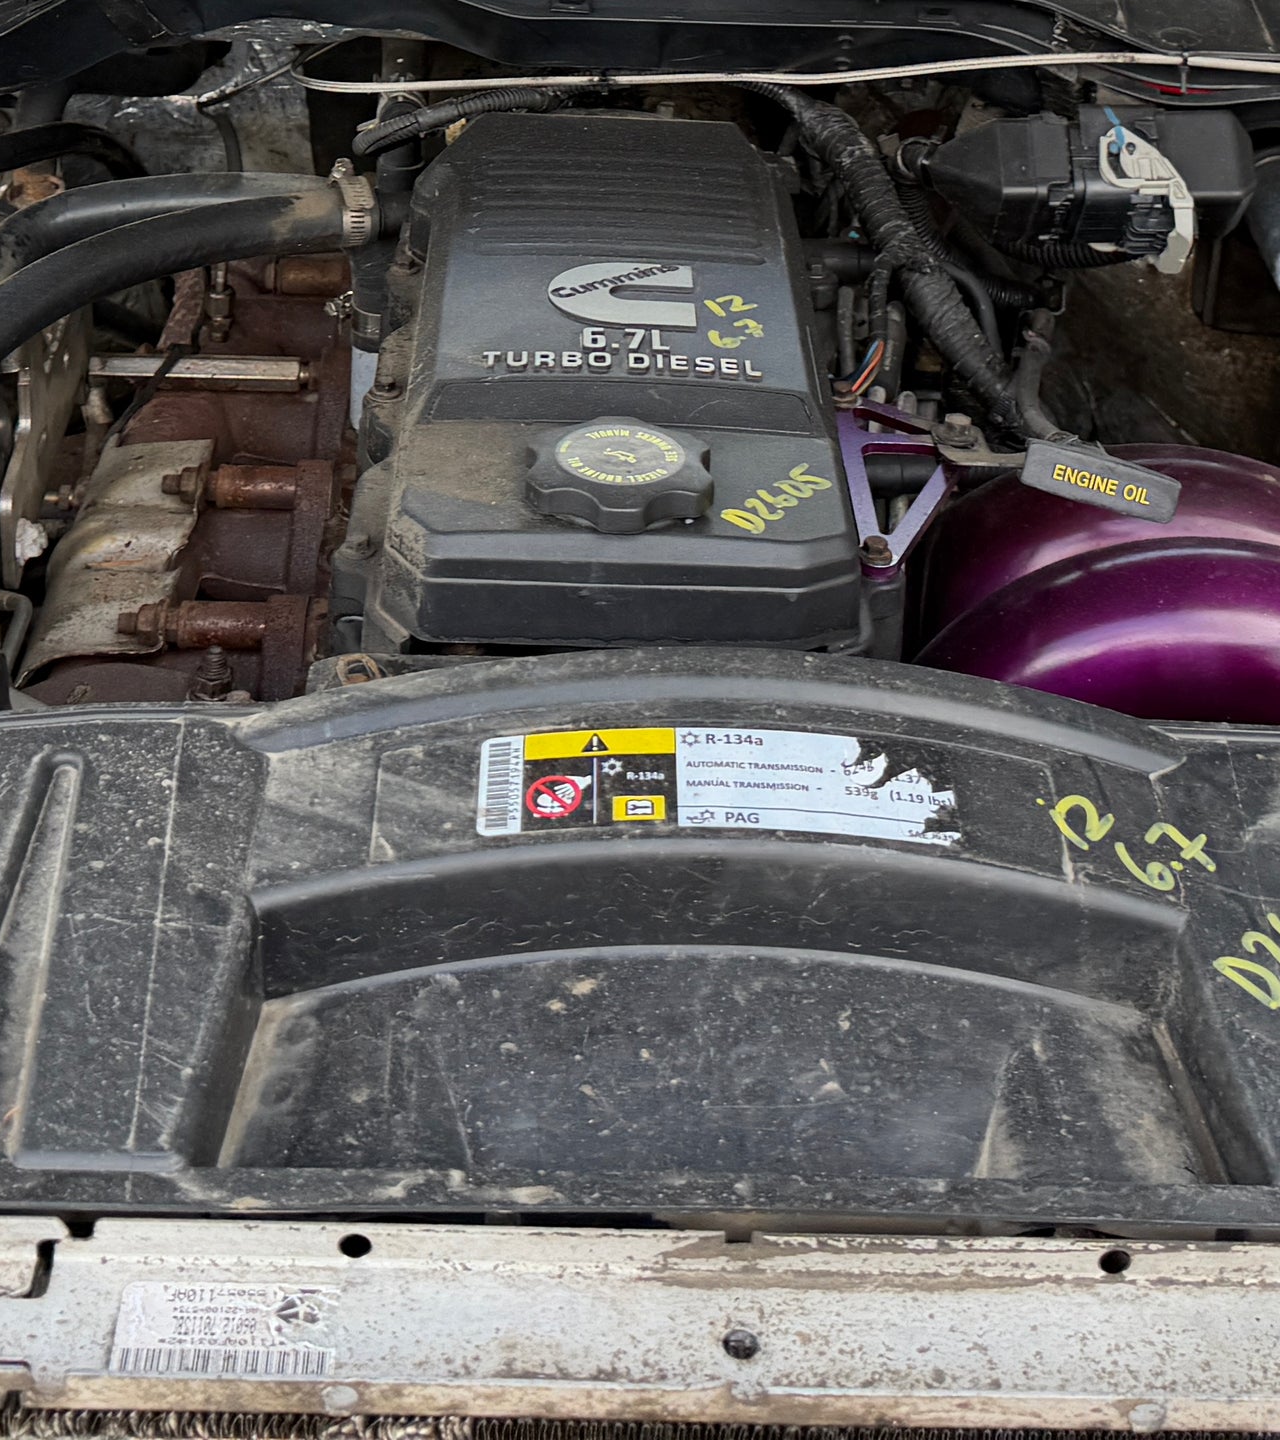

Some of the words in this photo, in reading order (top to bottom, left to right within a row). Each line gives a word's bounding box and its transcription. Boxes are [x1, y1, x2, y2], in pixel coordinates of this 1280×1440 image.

[550, 263, 680, 299] Cummins
[703, 295, 759, 318] 12
[581, 327, 670, 352] 6.7L
[482, 349, 613, 369] TURBO
[627, 352, 763, 378] DIESEL
[584, 429, 630, 440] MANUAL
[577, 465, 623, 483] ENGINE
[626, 468, 669, 483] DIESEL
[1052, 464, 1119, 496] ENGINE
[1123, 484, 1150, 505] OIL
[720, 462, 834, 535] D2605
[705, 733, 764, 746] R-134a
[686, 760, 746, 770] AUTOMATIC
[748, 761, 824, 774] TRANSMISSION
[686, 779, 731, 789] MANUAL
[733, 780, 809, 792] TRANSMISSION
[889, 790, 924, 804] (1.19
[724, 811, 760, 824] PAG
[1114, 822, 1216, 892] 6.7
